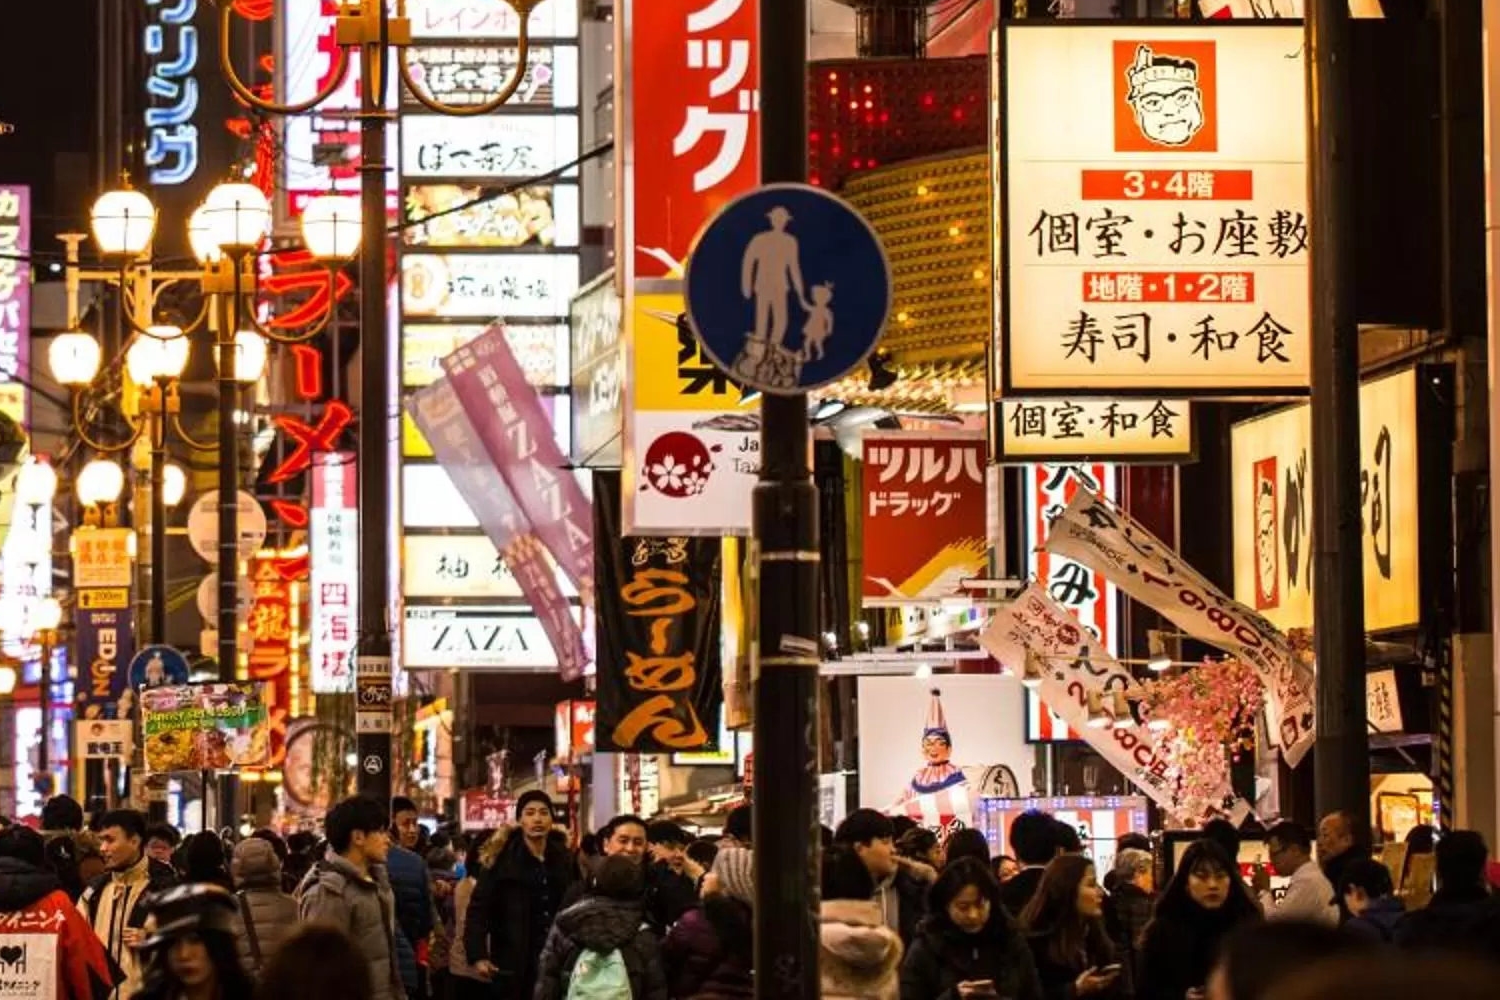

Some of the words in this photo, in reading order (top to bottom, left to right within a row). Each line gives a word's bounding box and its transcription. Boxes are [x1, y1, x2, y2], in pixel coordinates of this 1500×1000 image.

[1028, 207, 1309, 260] 個室・お座敷
[1060, 310, 1294, 364] 寿司・和食
[1008, 400, 1181, 440] 個室・和食
[867, 446, 984, 484] ツルハ
[868, 490, 962, 518] ドラッグ
[432, 624, 530, 652] ZAZA
[611, 567, 710, 749] らーめん
[90, 627, 118, 697] EDION
